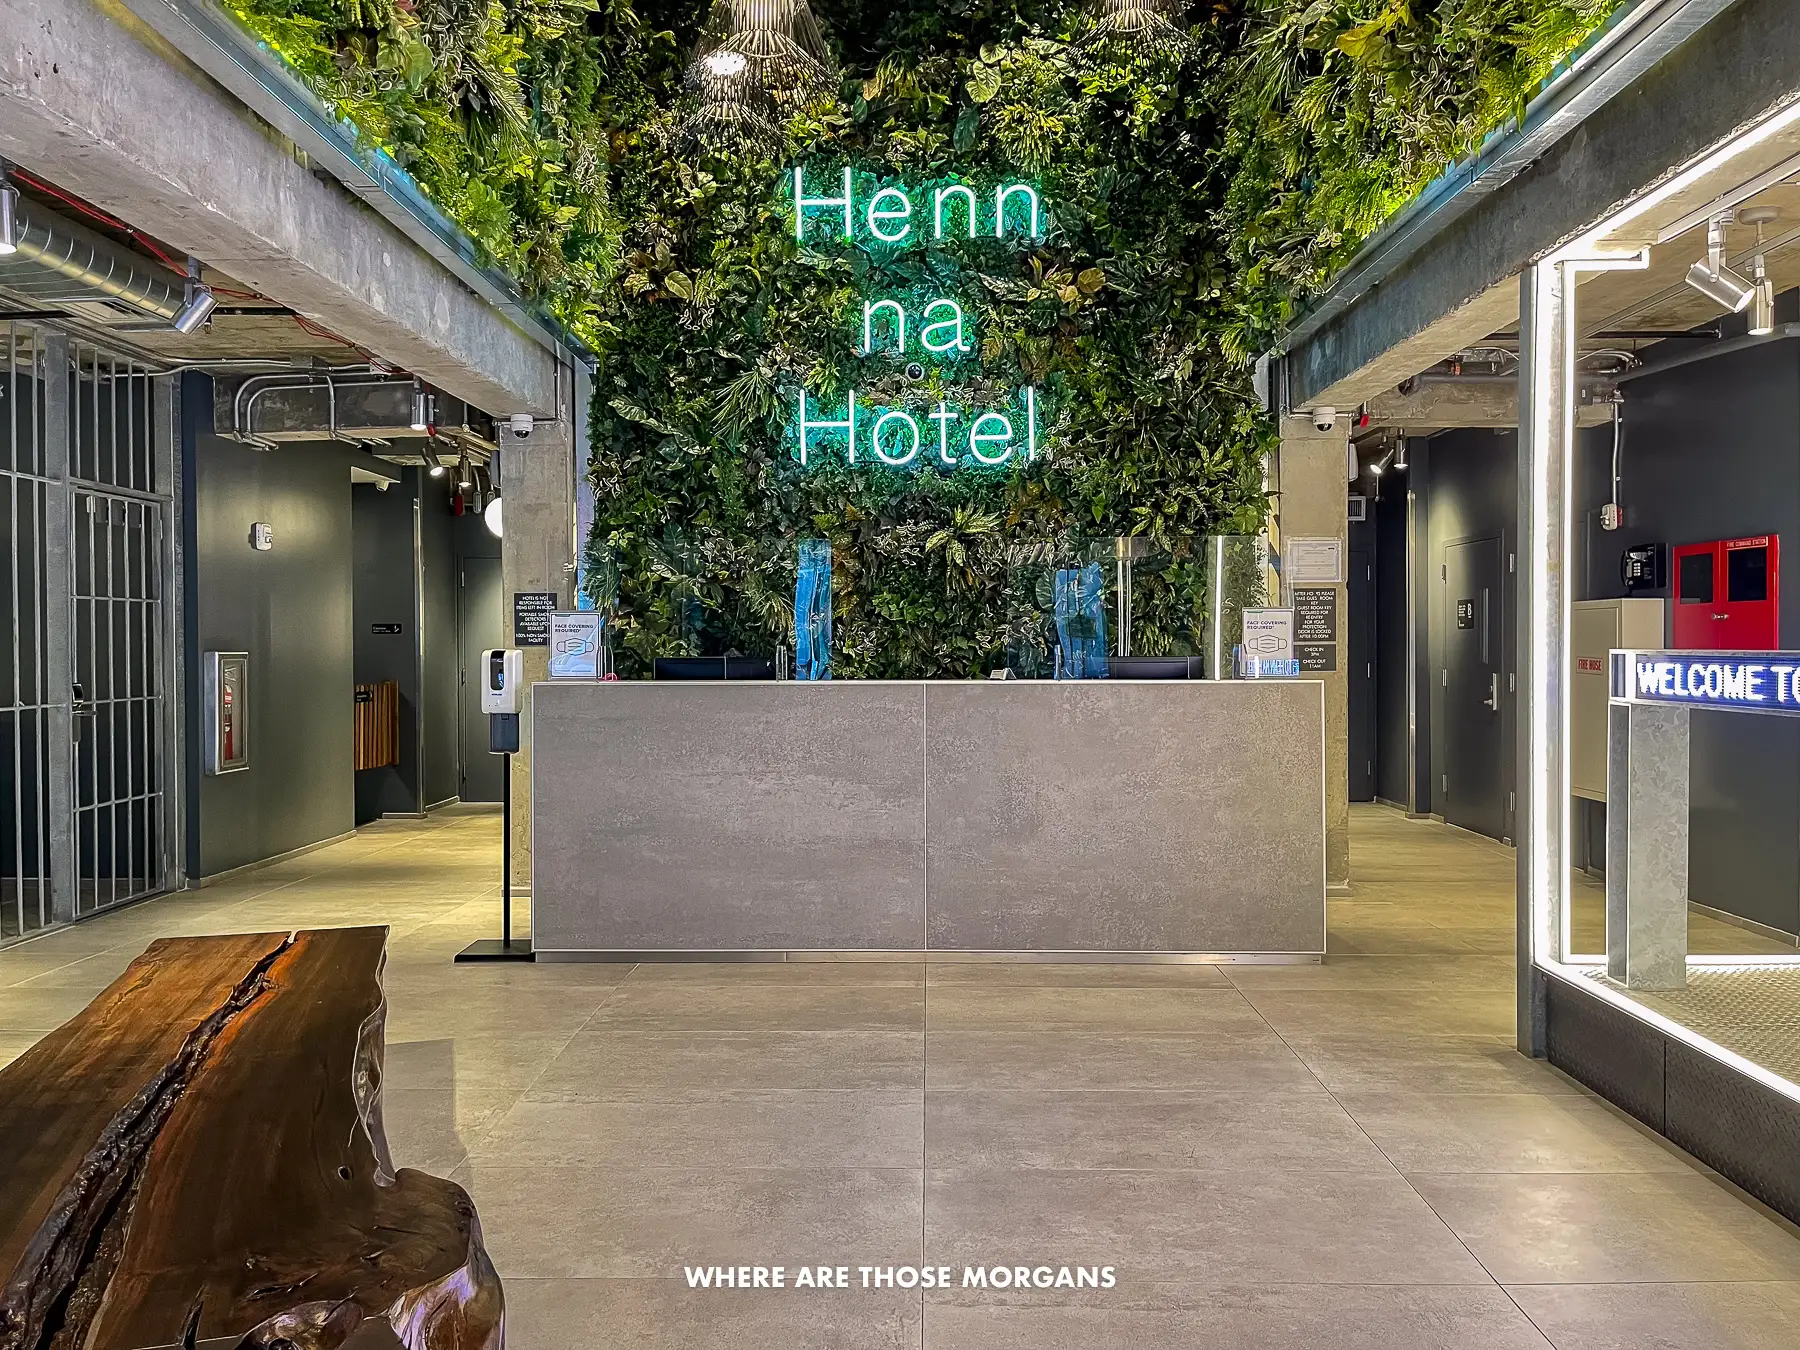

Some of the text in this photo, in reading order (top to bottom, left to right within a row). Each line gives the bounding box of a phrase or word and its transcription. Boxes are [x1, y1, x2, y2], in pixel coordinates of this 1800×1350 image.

[794, 167, 1037, 242] Henn
[864, 298, 971, 354] na
[800, 386, 1035, 466] Hotel
[1578, 659, 1601, 671] FIRE HOSE
[1637, 662, 1768, 701] WELCOME
